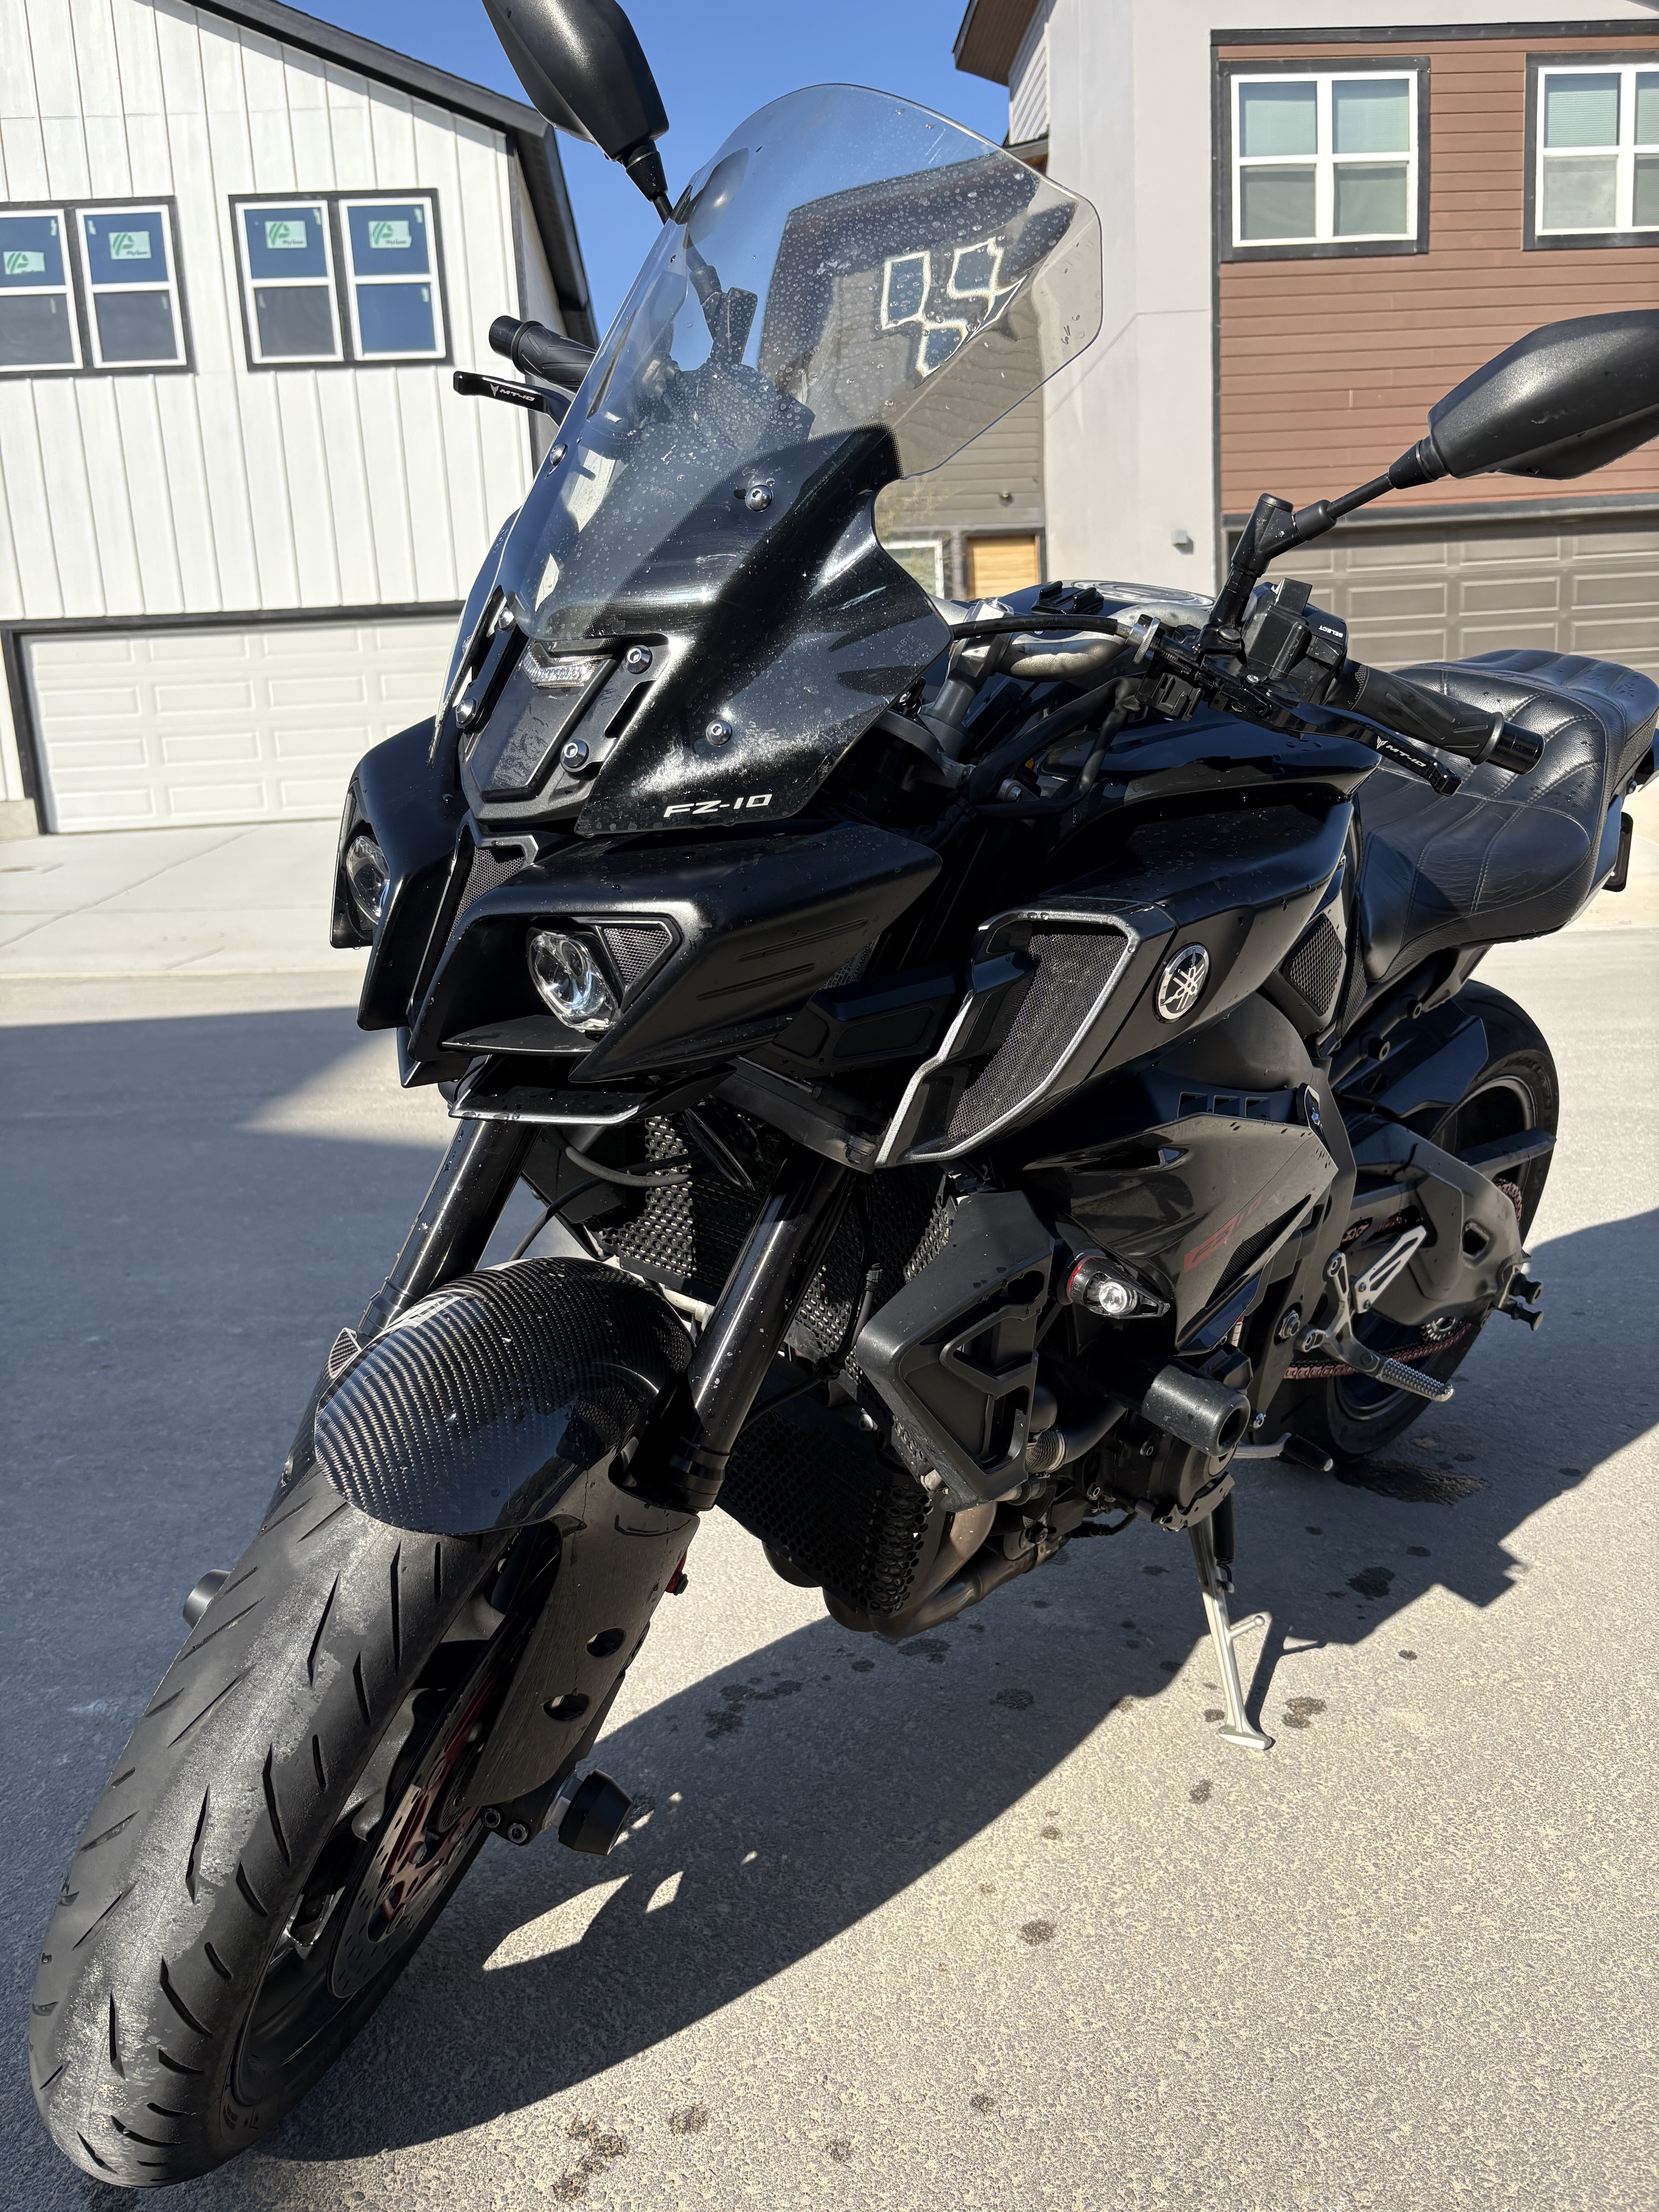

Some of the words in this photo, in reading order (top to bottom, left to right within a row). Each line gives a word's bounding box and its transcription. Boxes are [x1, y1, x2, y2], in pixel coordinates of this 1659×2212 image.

[499, 389, 535, 401] MT-10
[1318, 625, 1343, 638] SELECT
[1385, 745, 1427, 767] MT-10
[663, 794, 773, 817] FZ-10
